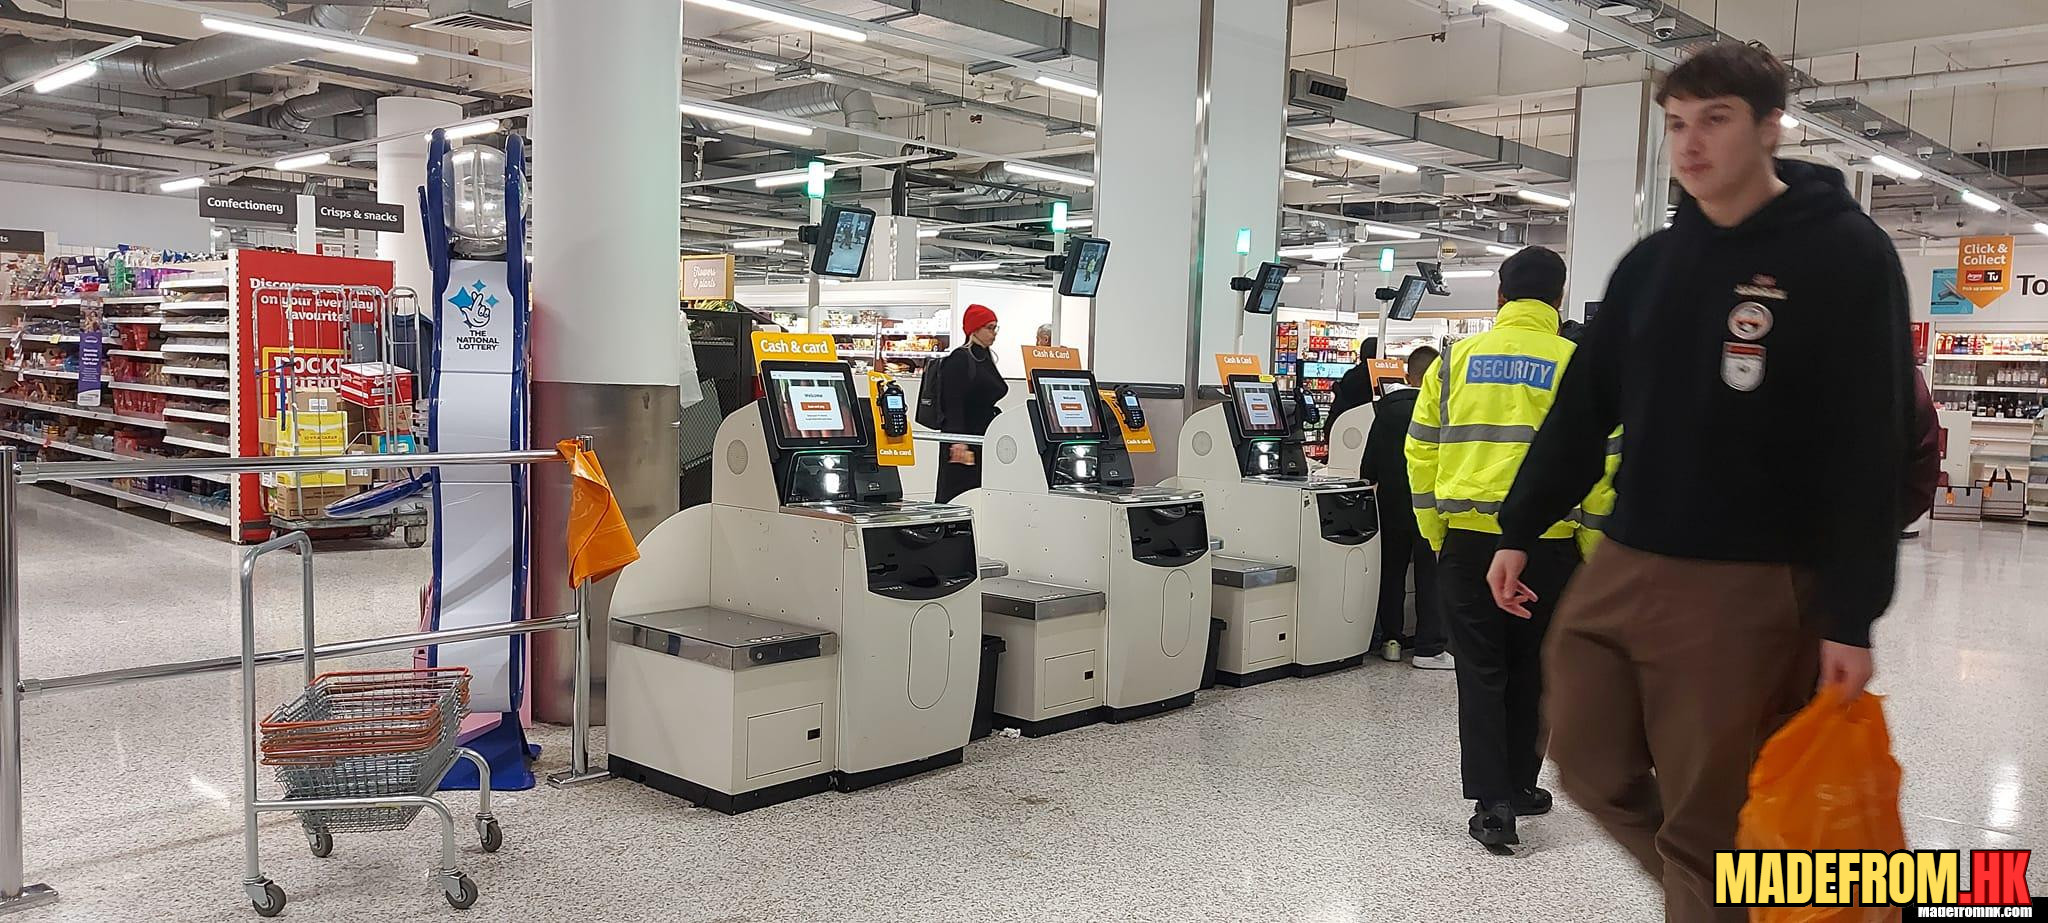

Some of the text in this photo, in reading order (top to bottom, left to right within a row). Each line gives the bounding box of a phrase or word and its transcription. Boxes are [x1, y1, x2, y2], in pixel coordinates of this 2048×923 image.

[206, 196, 284, 215] Confectionery
[320, 206, 398, 222] Crisps & snacks
[1964, 243, 2008, 254] Click &
[1963, 254, 2006, 265] Collect
[1987, 271, 1998, 281] Tu
[249, 277, 306, 291] Discov
[2016, 274, 2048, 296] To
[260, 295, 278, 304] on
[281, 296, 312, 308] your
[760, 339, 829, 353] Cash & card
[1033, 349, 1070, 359] Cash & Card
[1223, 356, 1236, 364] Cash
[1472, 360, 1551, 383] SECURITY
